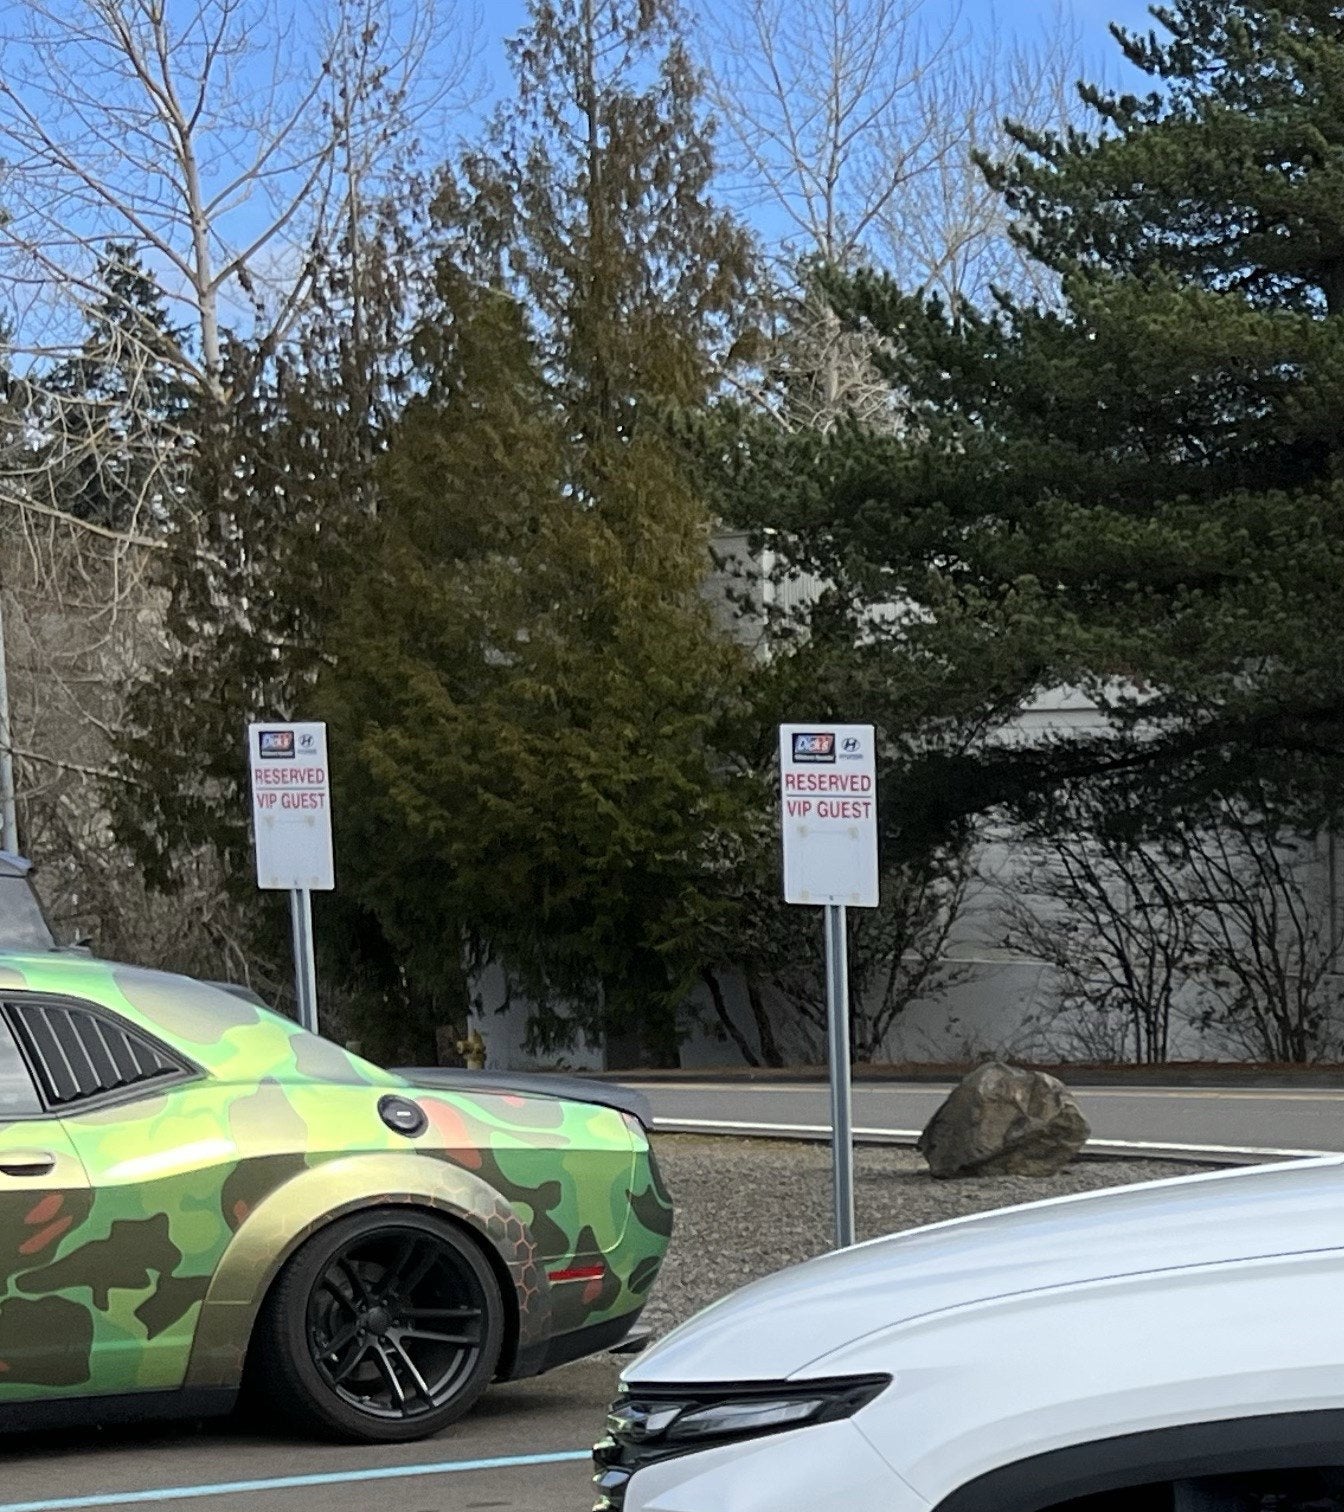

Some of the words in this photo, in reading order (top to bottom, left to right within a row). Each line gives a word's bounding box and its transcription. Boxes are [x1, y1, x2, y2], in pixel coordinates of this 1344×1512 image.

[254, 768, 325, 785] RESERVED
[785, 773, 871, 792] RESERVED
[256, 793, 277, 809] VIP
[281, 792, 325, 809] GUEST
[787, 800, 812, 818] VIP
[817, 800, 871, 819] GUEST
